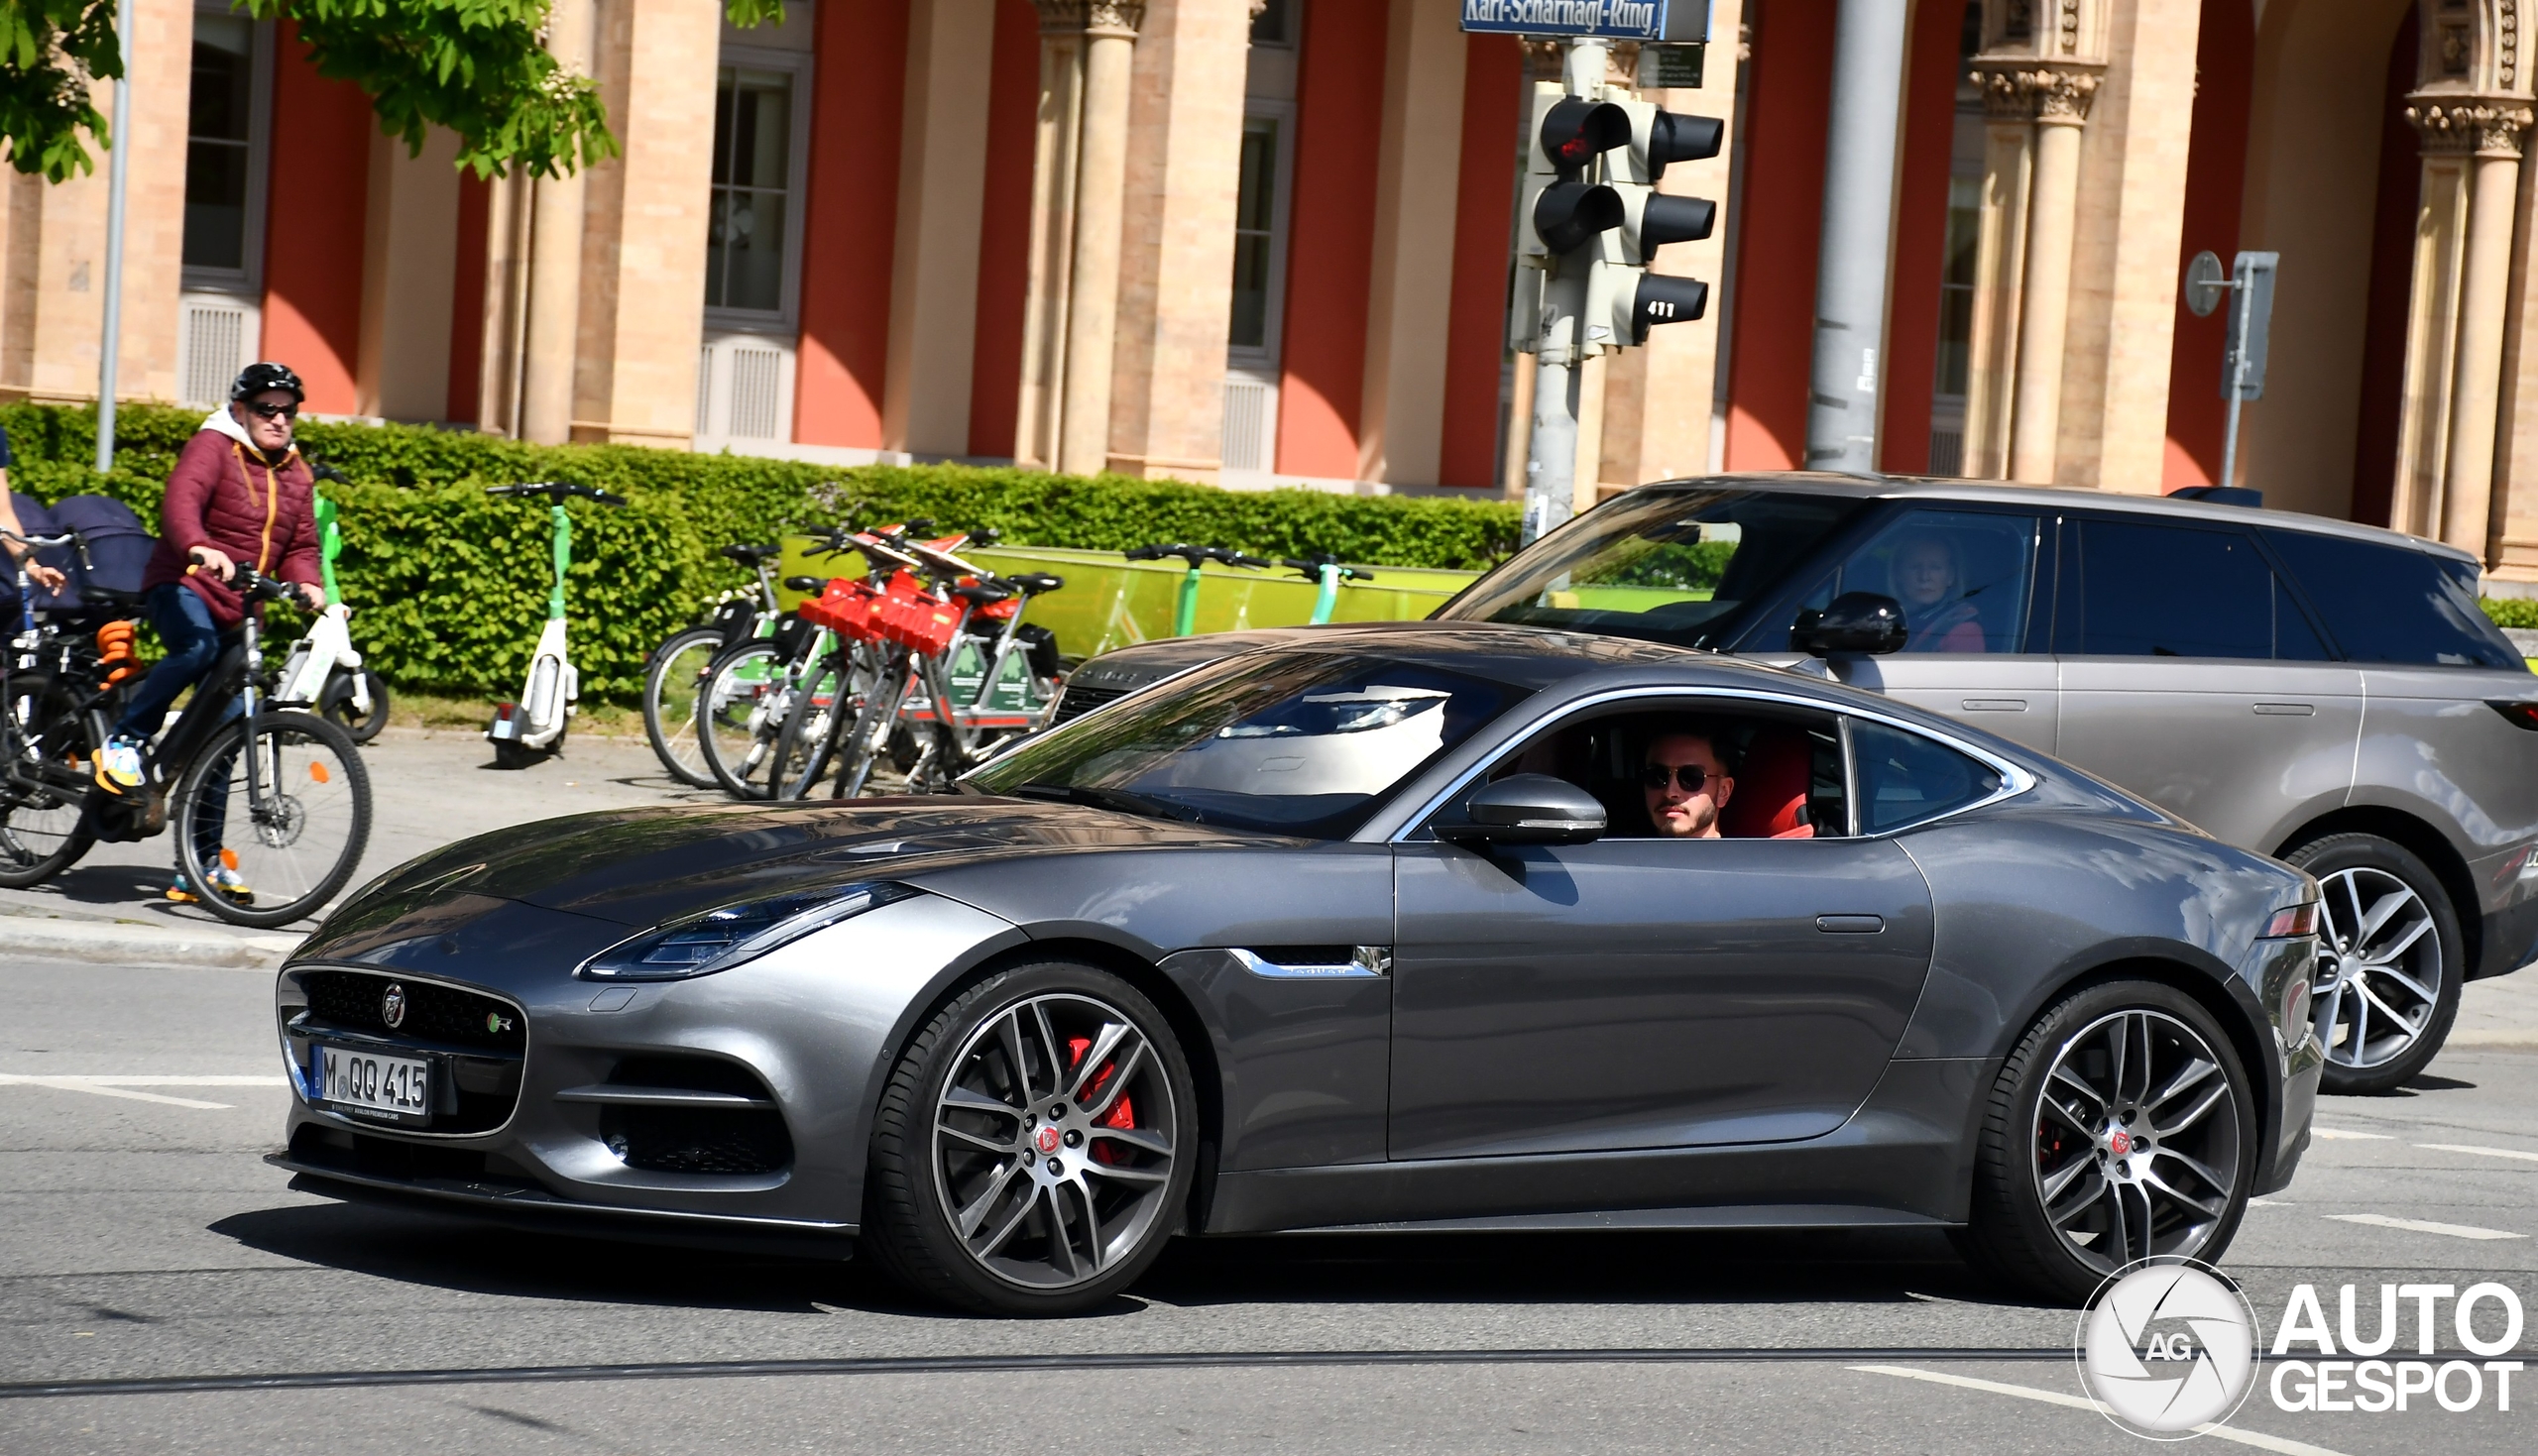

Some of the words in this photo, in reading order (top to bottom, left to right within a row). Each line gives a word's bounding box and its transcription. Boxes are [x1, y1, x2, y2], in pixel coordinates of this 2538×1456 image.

[1465, 0, 1655, 36] Karl-Scharnagl-Ring
[1647, 300, 1674, 318] 411
[323, 1052, 336, 1095] M
[350, 1057, 378, 1101] QQ
[383, 1063, 425, 1108] 415
